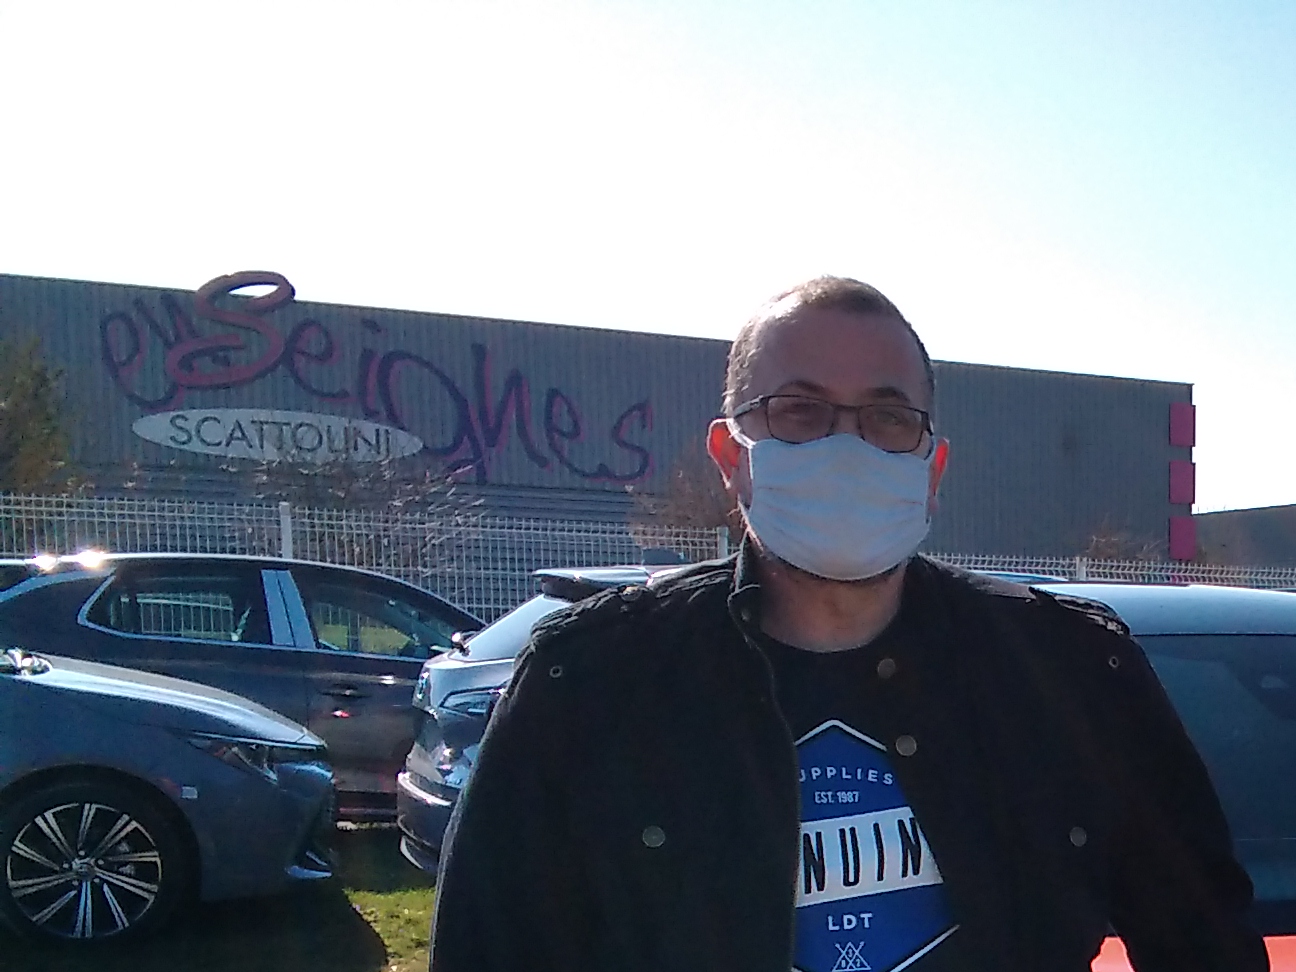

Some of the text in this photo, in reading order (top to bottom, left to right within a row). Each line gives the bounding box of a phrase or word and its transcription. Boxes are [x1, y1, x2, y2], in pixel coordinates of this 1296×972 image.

[168, 414, 391, 456] SCATTOLINI
[802, 816, 922, 894] NUIN
[828, 912, 873, 931] LDT
